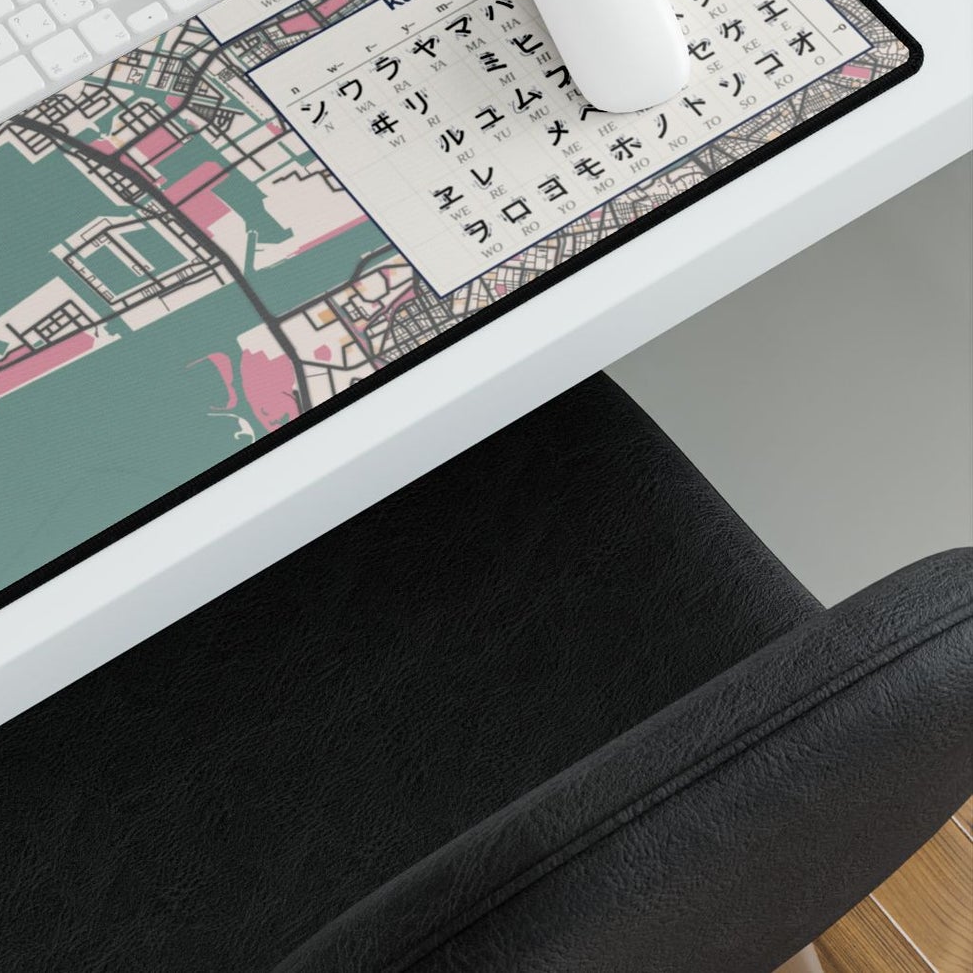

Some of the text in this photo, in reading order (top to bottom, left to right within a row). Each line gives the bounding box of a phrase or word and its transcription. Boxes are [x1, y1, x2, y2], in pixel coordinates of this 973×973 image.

[485, 0, 515, 21] ハ
[708, 3, 728, 20] KU
[758, 0, 788, 22] エ
[445, 16, 472, 37] マ
[722, 20, 742, 42] ケ
[413, 38, 440, 58] ヤ
[465, 37, 487, 53] MA
[510, 34, 544, 55] ヒ
[688, 41, 714, 60] セ
[742, 38, 761, 54] KE
[789, 32, 815, 56] オ
[375, 57, 399, 81] ラ
[479, 52, 507, 72] ミ
[755, 53, 783, 75] コ
[393, 80, 412, 94] RA
[498, 71, 516, 87] MI
[544, 64, 572, 89] フ
[719, 73, 741, 97] ソ
[774, 74, 794, 90] KO
[339, 79, 362, 101] ワ
[515, 88, 543, 110] ム
[301, 101, 325, 124] ン
[405, 92, 428, 115] リ
[528, 105, 550, 123] MU
[684, 97, 705, 116] ト
[371, 114, 399, 135] ヰ
[426, 114, 441, 128] RI
[475, 108, 505, 130] ユ
[659, 114, 667, 138] ノ
[441, 129, 464, 153] ル
[547, 120, 569, 146] メ
[456, 148, 475, 164] RU
[561, 141, 583, 158] ME
[610, 137, 641, 161] ホ
[470, 167, 493, 186] レ
[574, 158, 605, 176] モ
[489, 184, 507, 200] RE
[538, 178, 568, 201] ヨ
[593, 177, 615, 195] MO
[434, 186, 464, 210] ヱ
[501, 199, 532, 224] ロ
[464, 220, 488, 243] ヲ
[521, 221, 540, 237] RO
